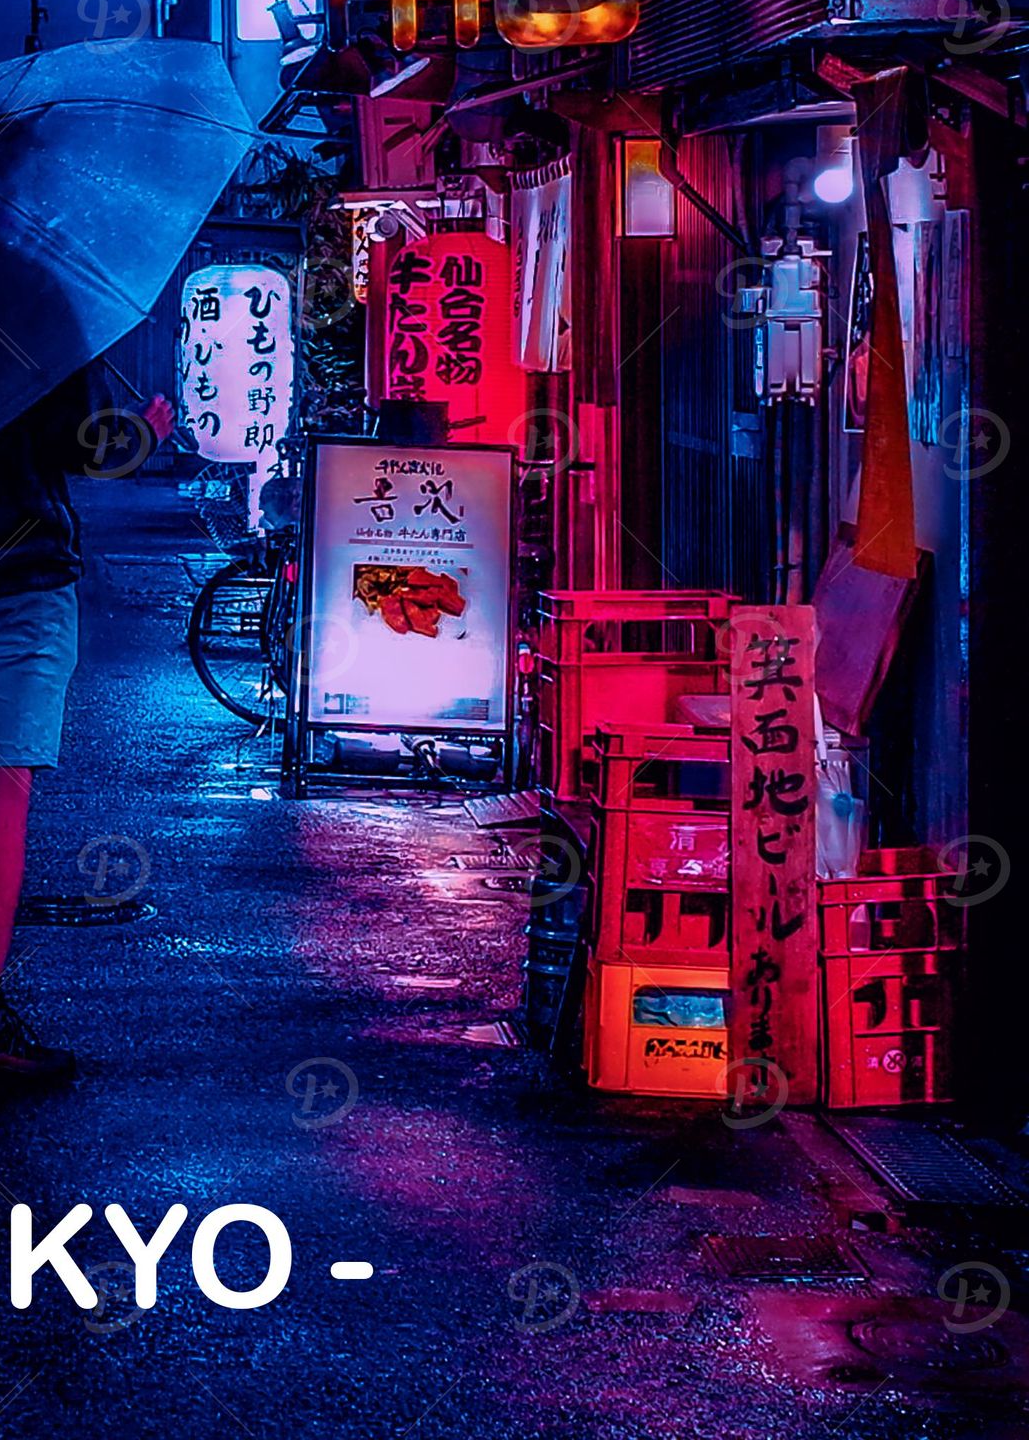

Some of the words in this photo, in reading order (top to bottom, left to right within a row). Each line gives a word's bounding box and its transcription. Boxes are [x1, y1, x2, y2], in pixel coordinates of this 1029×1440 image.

[244, 286, 280, 453] ひもの野郎
[436, 255, 484, 385] 仙台名物
